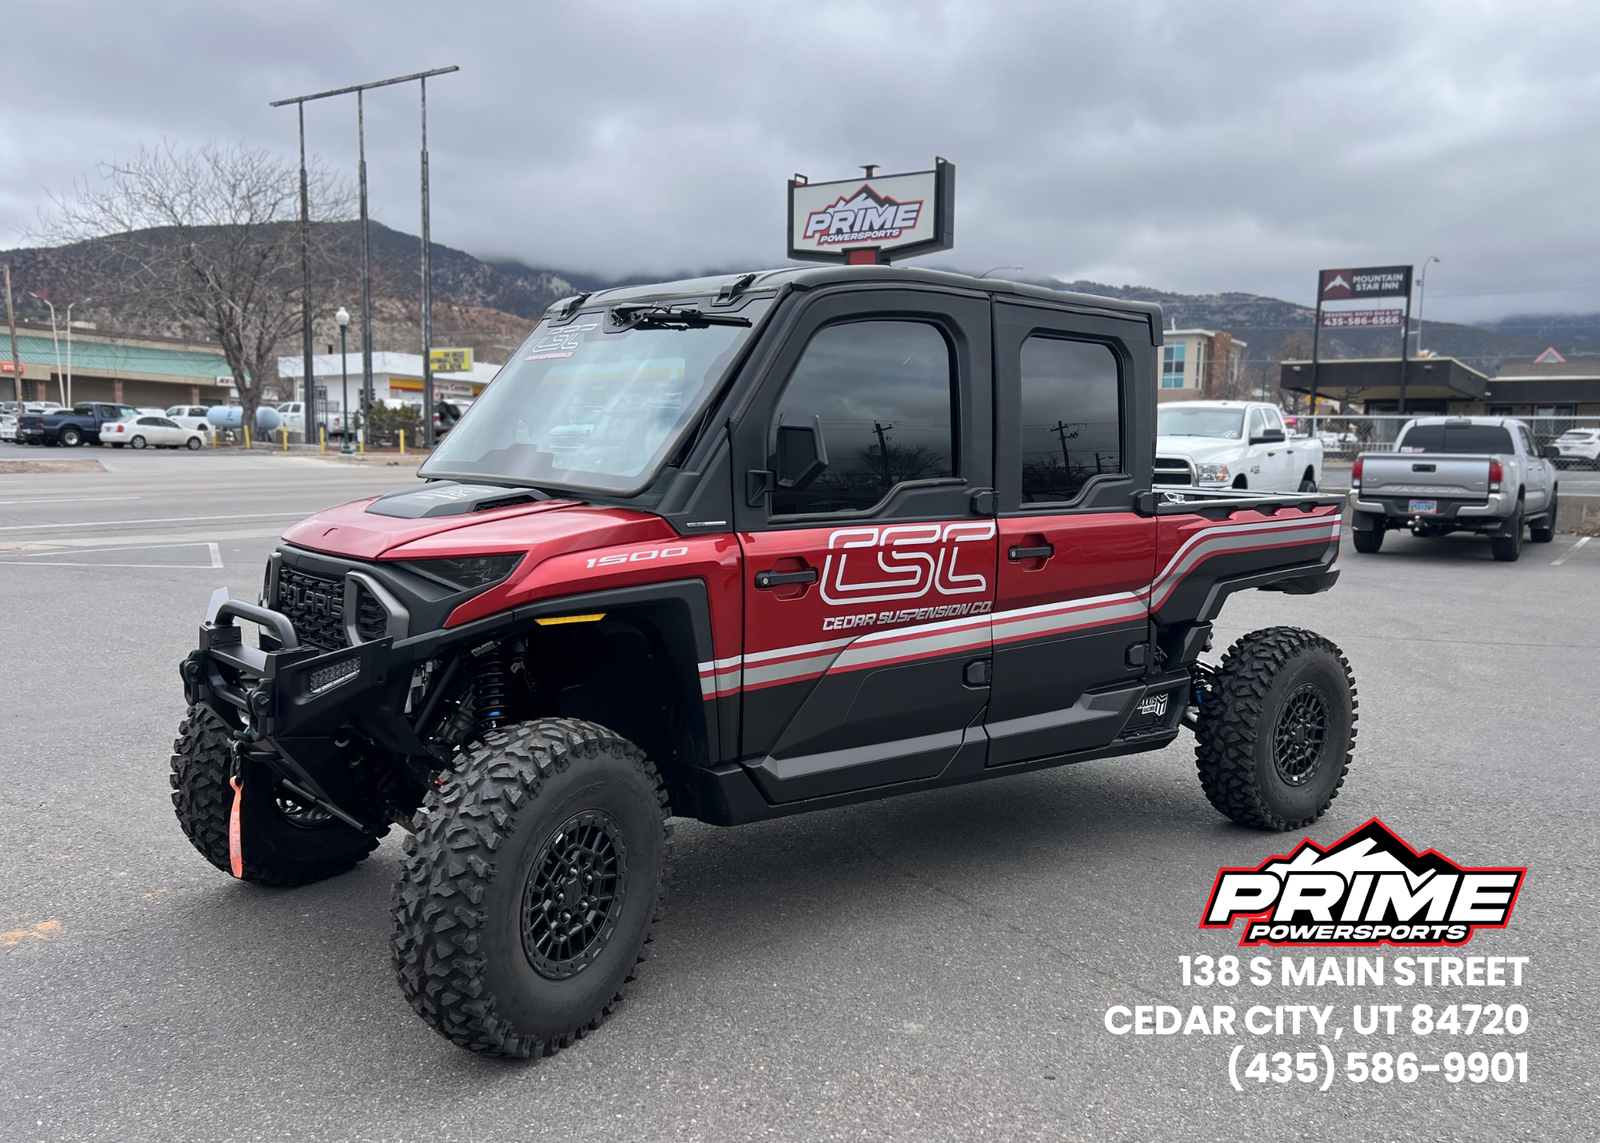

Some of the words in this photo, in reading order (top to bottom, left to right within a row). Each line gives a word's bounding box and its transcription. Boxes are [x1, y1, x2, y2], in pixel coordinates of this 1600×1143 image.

[806, 203, 920, 237] PRIME
[820, 228, 900, 243] POWERSPORTS
[1353, 273, 1403, 283] MOUNTAIN
[1356, 282, 1380, 291] STAR
[1381, 282, 1399, 290] INN
[1324, 316, 1399, 326] 435-586-6566
[586, 547, 688, 569] 1500
[820, 522, 995, 605] CSC
[279, 581, 344, 620] POLARIS
[822, 612, 877, 632] CEDAR
[876, 603, 971, 626] SUSPENSION
[969, 600, 993, 614] CO.
[471, 640, 494, 654] POLARIS
